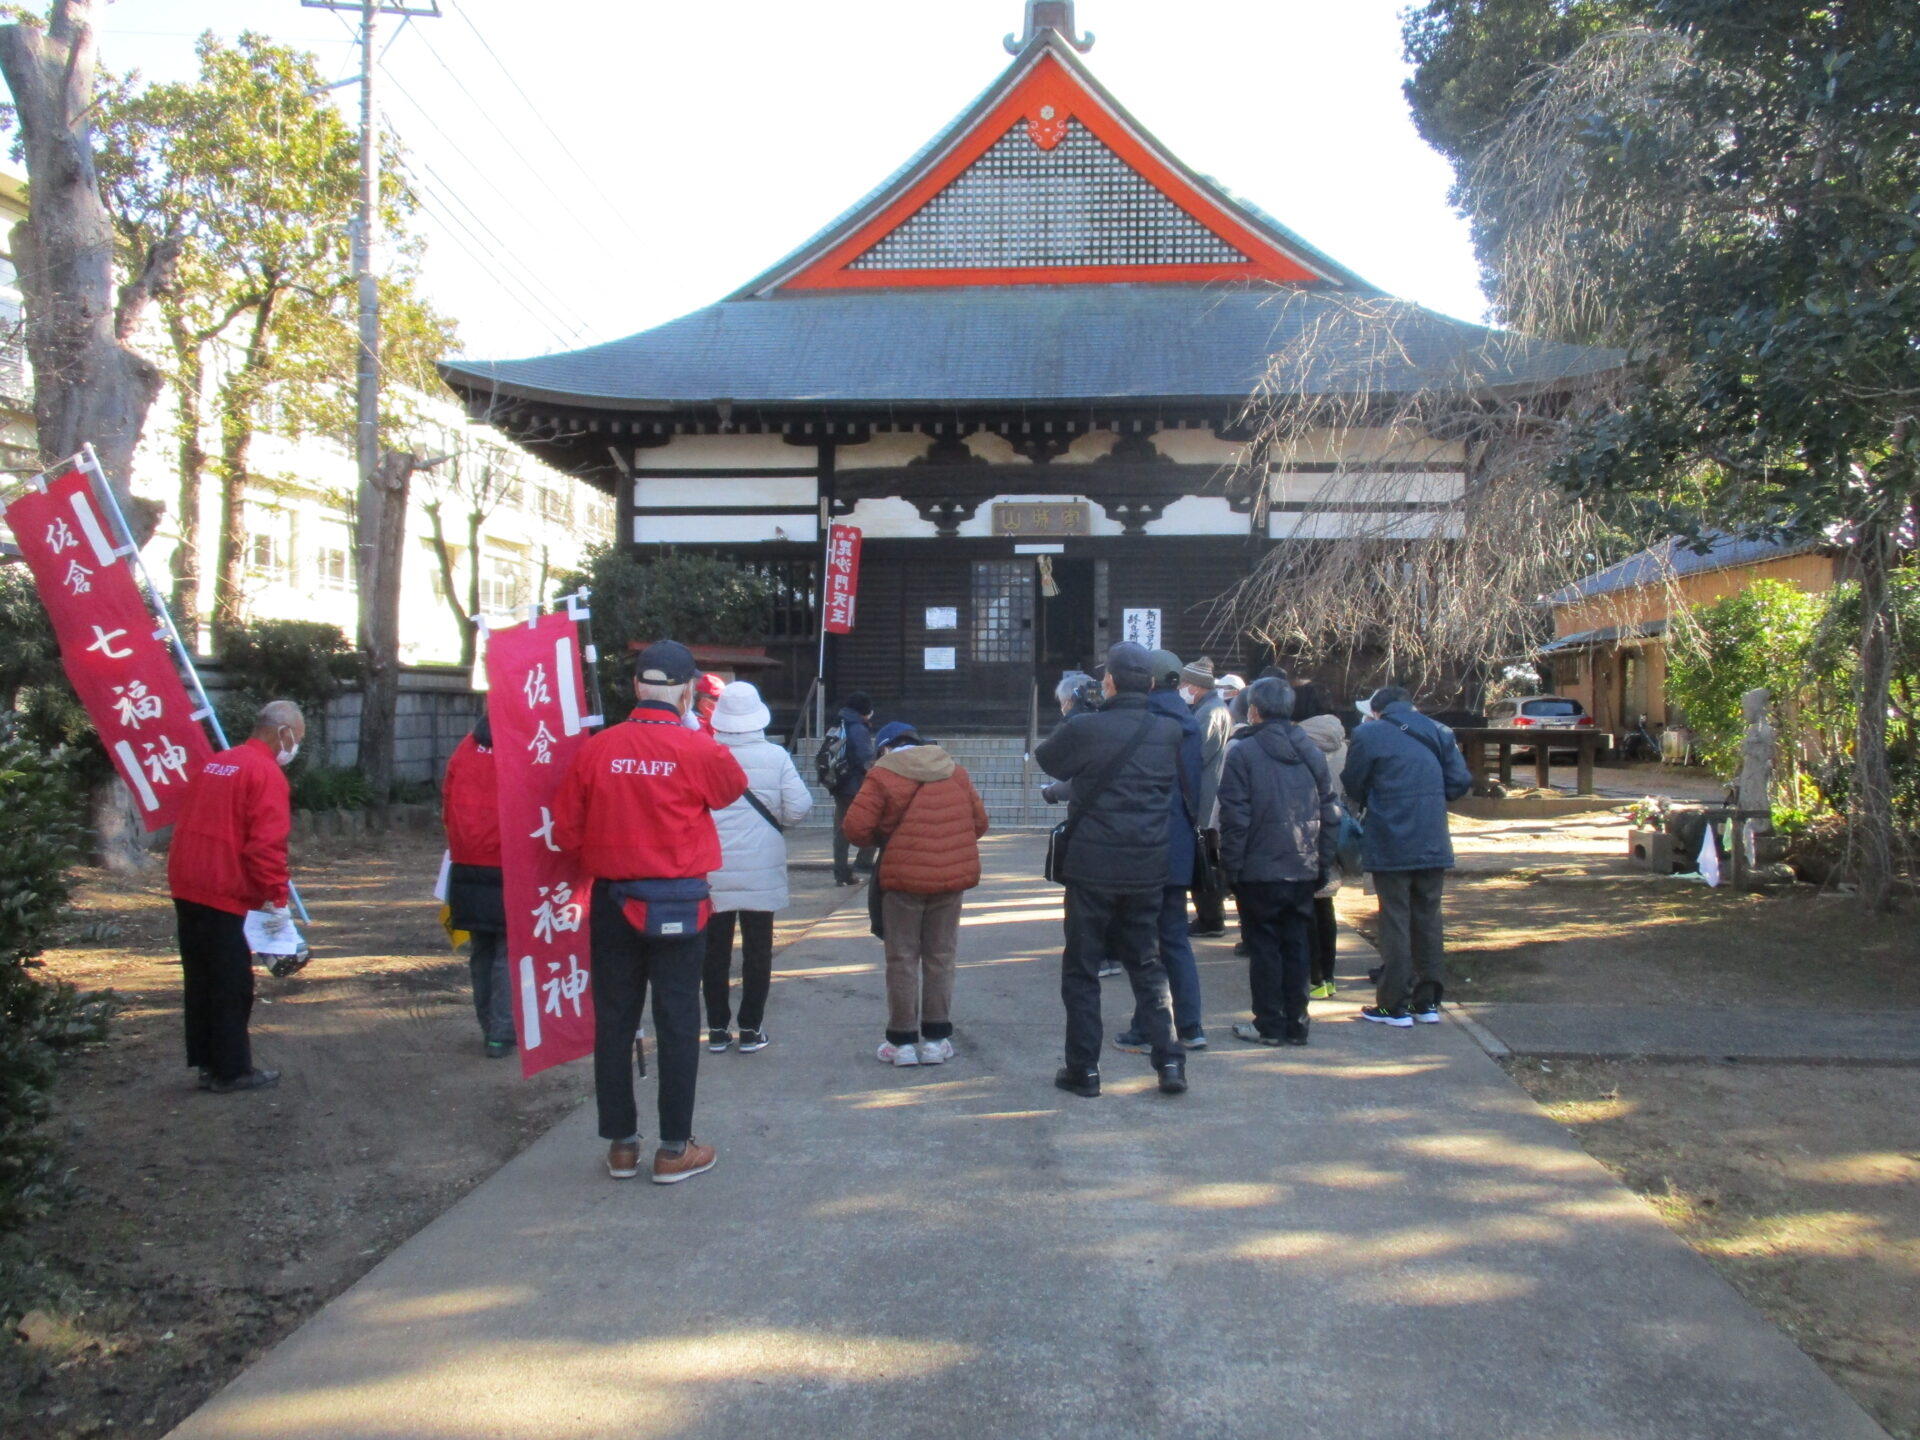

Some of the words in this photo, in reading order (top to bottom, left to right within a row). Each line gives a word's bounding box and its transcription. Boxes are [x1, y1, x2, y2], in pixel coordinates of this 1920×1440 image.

[46, 517, 188, 785] 佐倉七福神
[610, 758, 677, 777] STAFF
